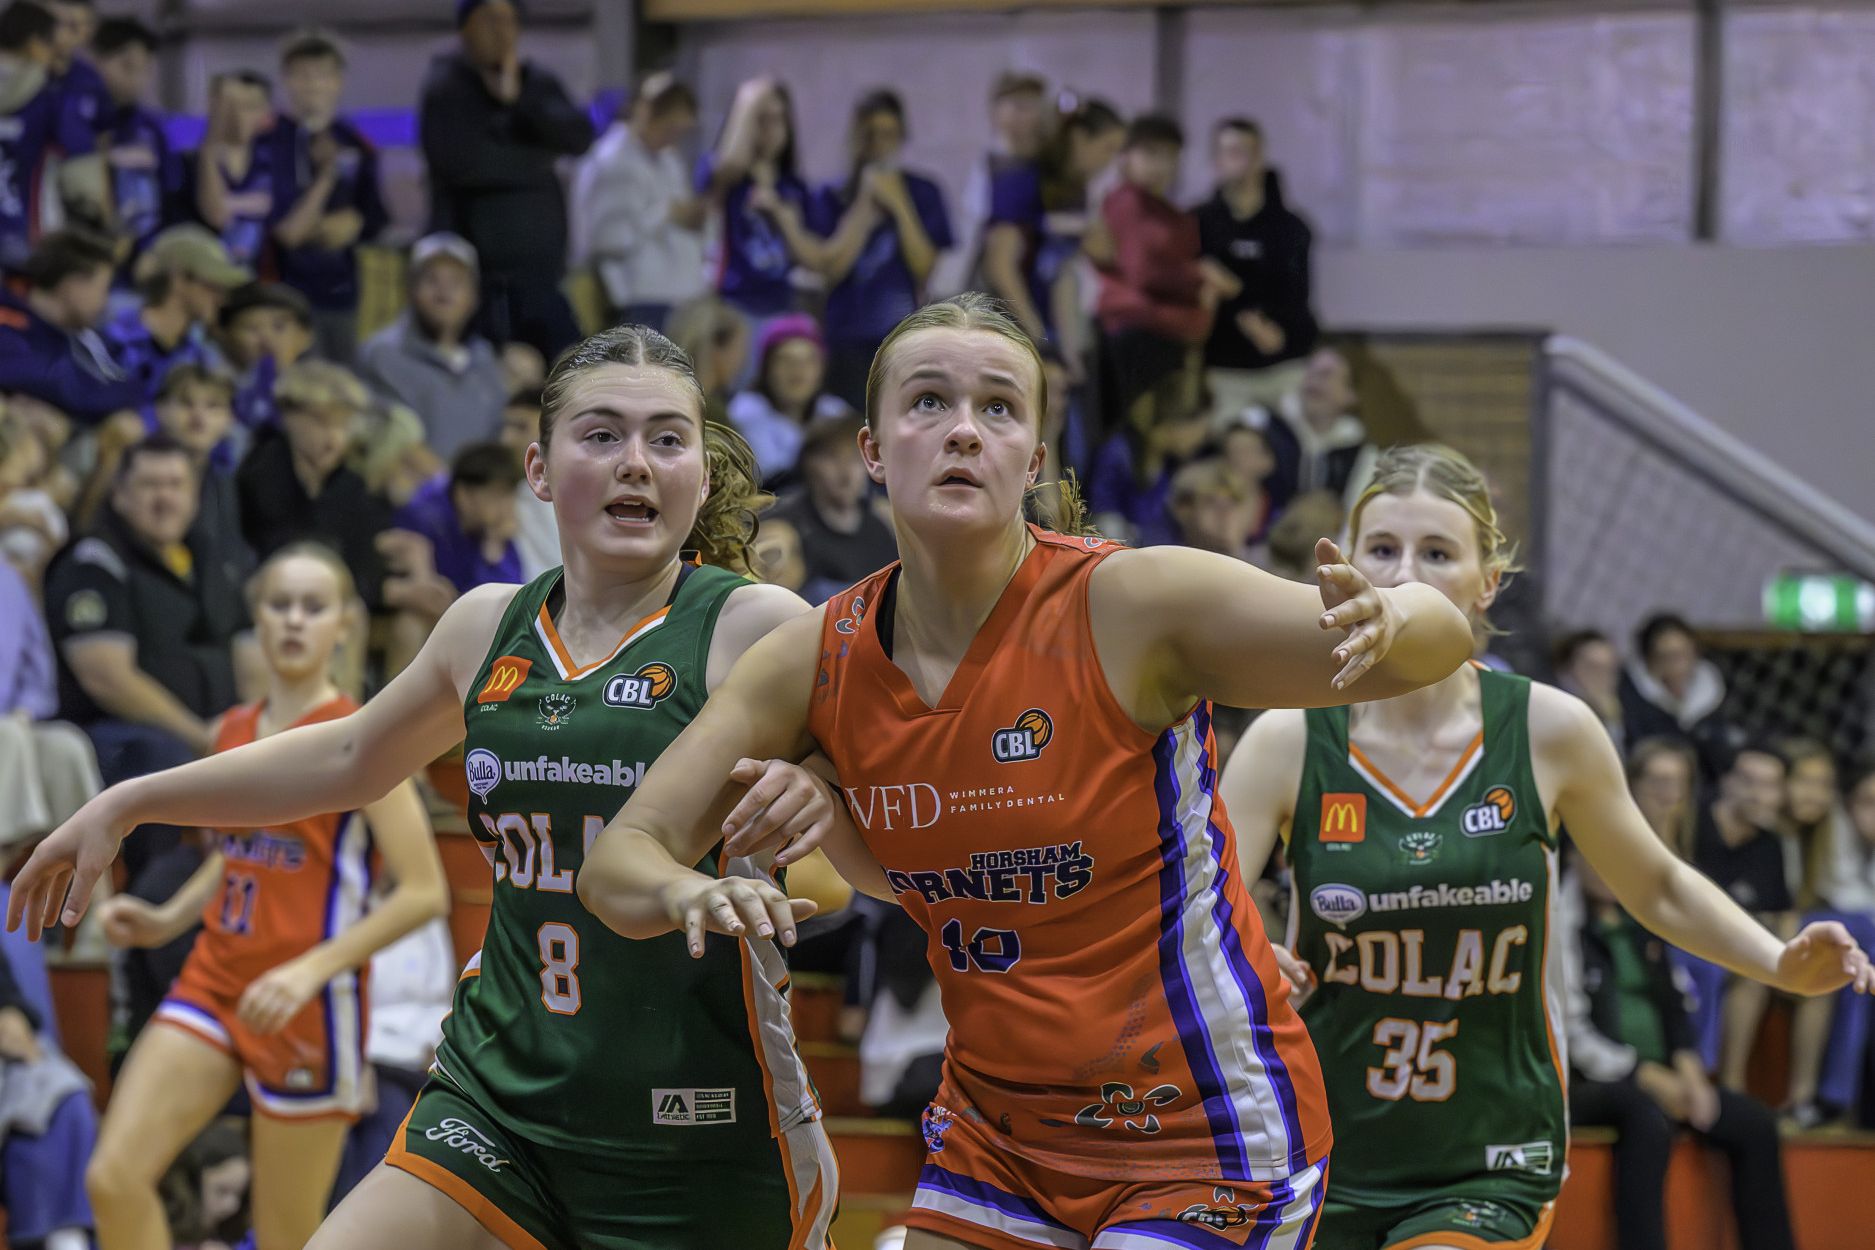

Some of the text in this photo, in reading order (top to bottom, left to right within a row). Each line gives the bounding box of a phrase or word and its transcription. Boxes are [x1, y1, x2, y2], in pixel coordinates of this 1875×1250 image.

[545, 693, 571, 704] COLAC
[607, 678, 653, 706] CBL
[994, 731, 1037, 758] CBL
[468, 755, 646, 788] Bulla unfakeabl
[950, 785, 1015, 800] WIMMERA
[950, 793, 1065, 814] FAMILY DENTAL
[1464, 804, 1505, 833] CBL
[969, 841, 1083, 871] HORSHAM
[883, 854, 1094, 904] ORNETS
[1316, 878, 1533, 912] Bulla unfakeable
[941, 917, 1022, 974] 10
[1323, 924, 1528, 1000] COLAC
[537, 920, 582, 1016] 8
[1365, 1016, 1459, 1102] 35
[425, 1117, 510, 1173] Ford
